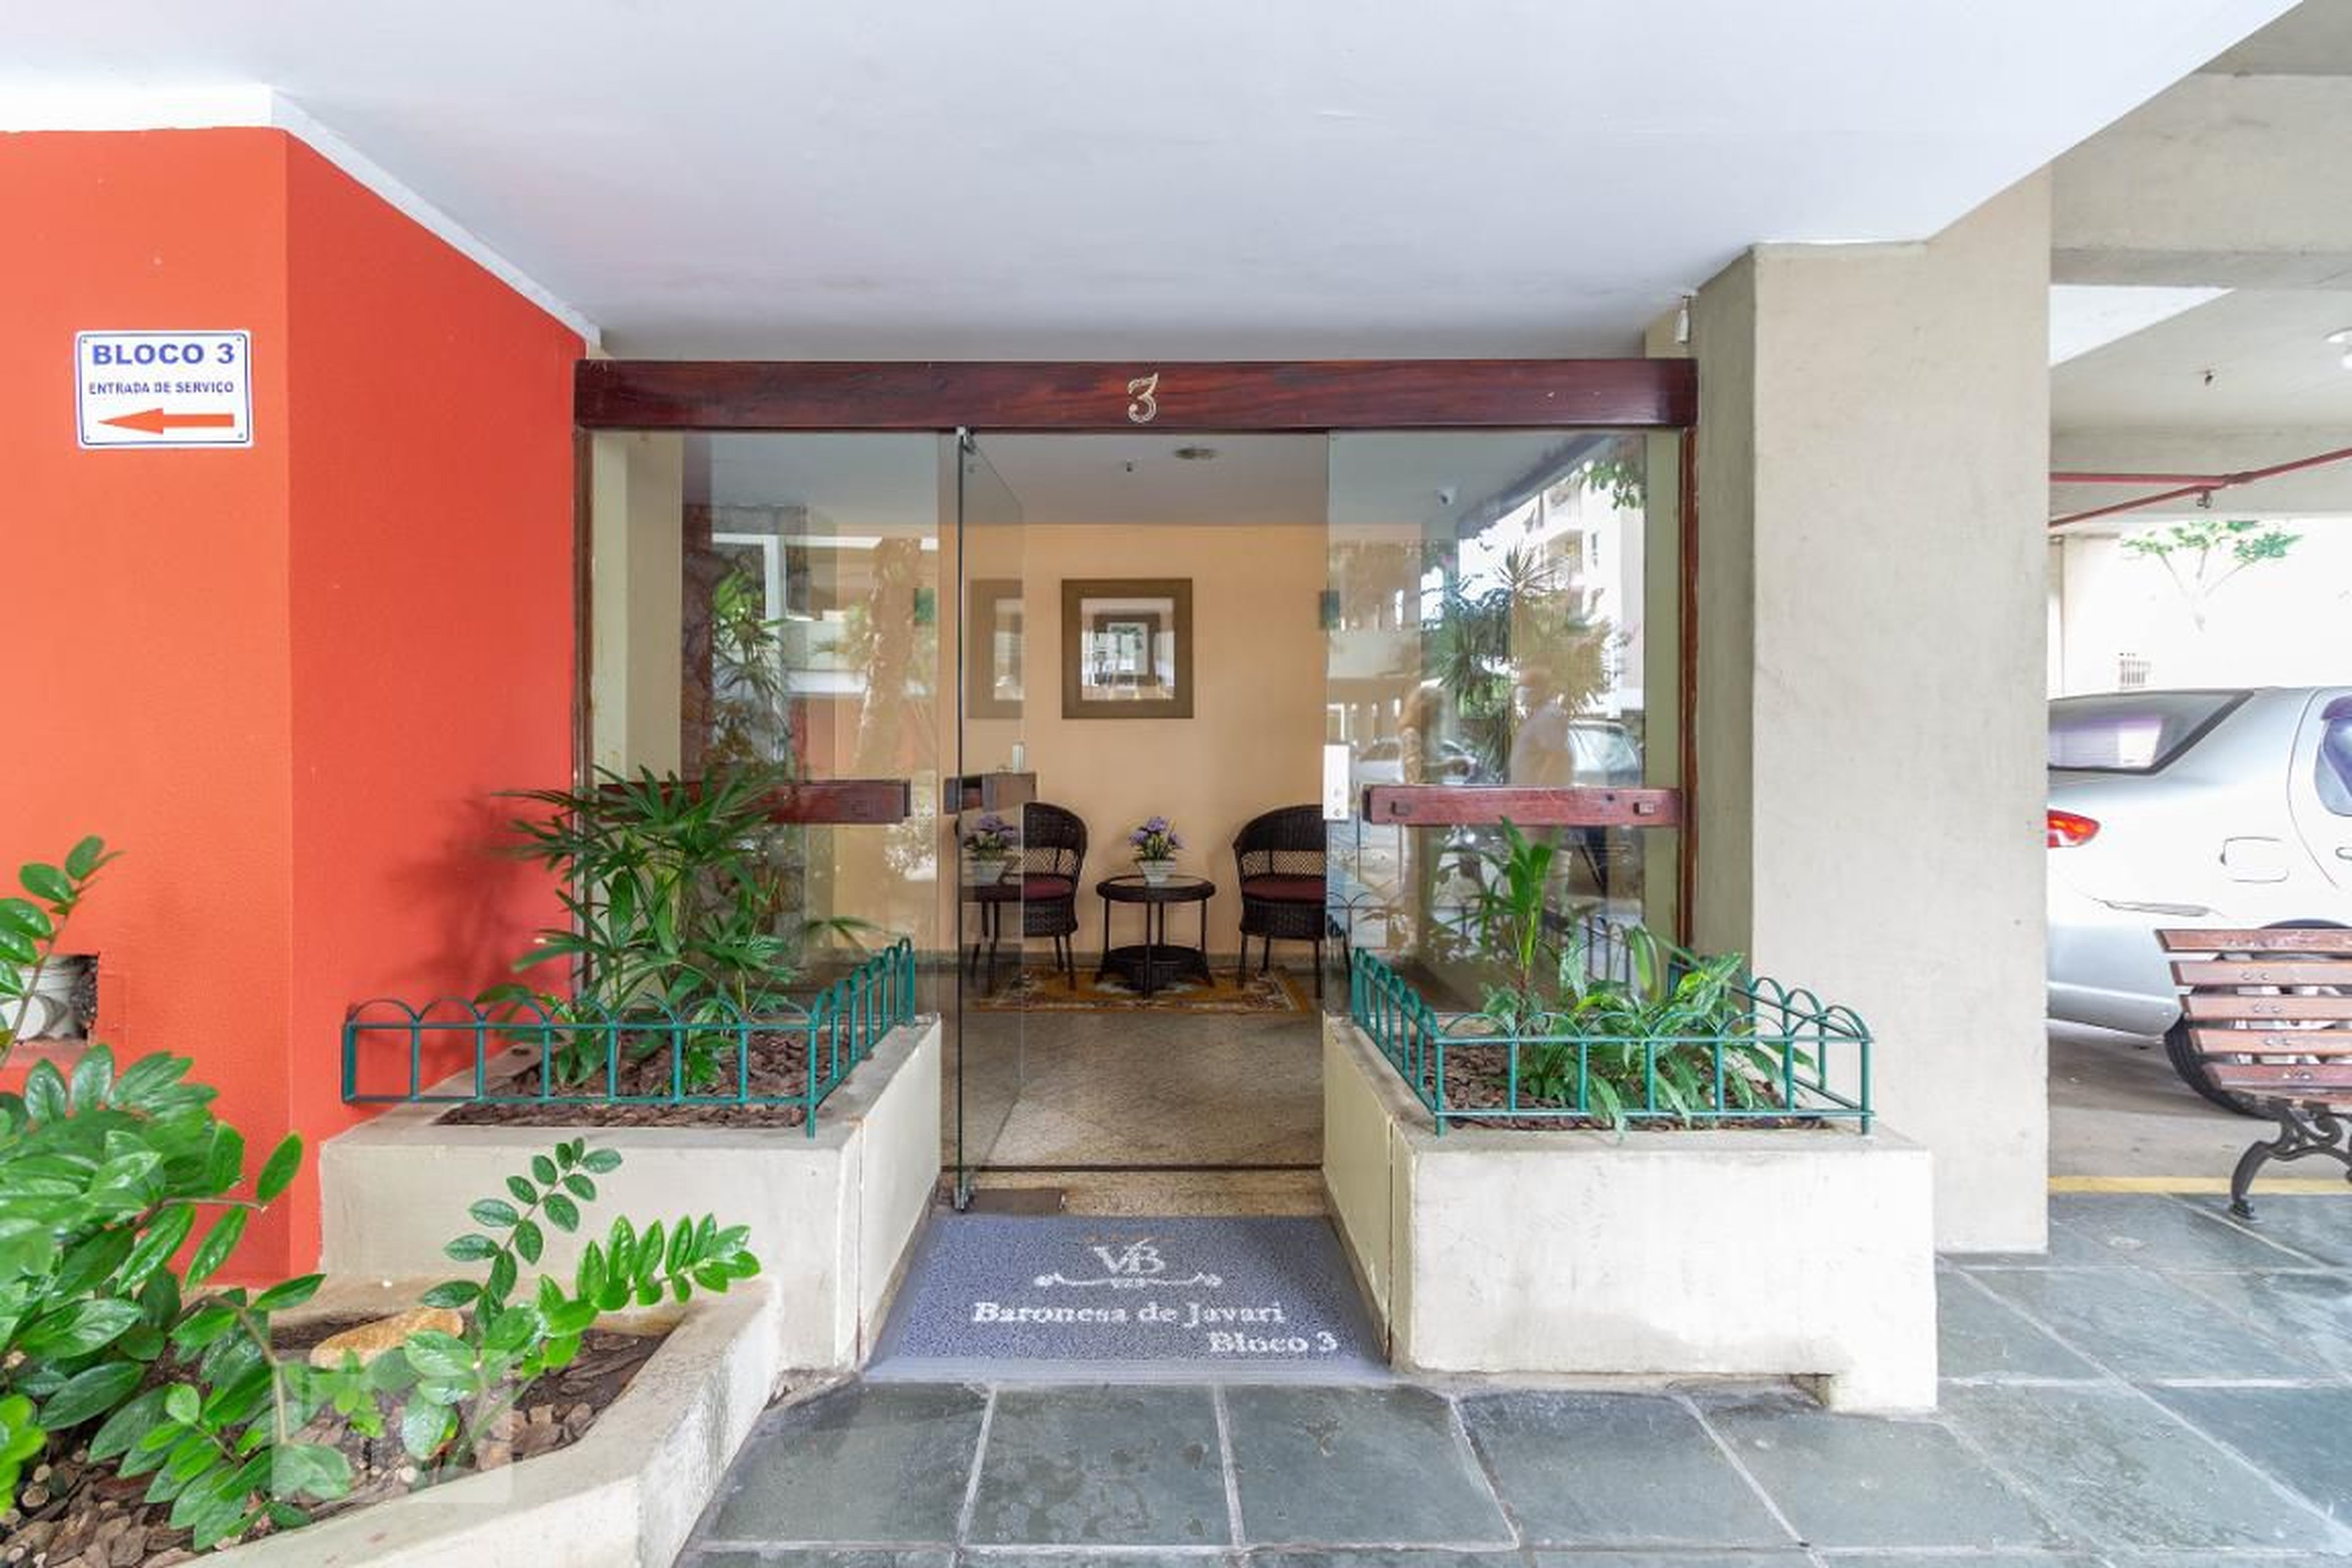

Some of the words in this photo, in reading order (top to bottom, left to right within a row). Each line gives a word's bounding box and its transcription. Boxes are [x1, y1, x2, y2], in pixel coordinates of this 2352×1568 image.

[92, 344, 204, 365] BLOCO
[217, 343, 235, 364] 3
[89, 382, 150, 394] ENTRADA
[154, 382, 172, 394] DE
[1128, 372, 1158, 423] 3
[973, 1302, 1128, 1322] Baronesa
[1138, 1302, 1177, 1322] de
[1184, 1301, 1286, 1328] Javari
[1207, 1332, 1310, 1352] Bloco
[1317, 1330, 1338, 1351] 3
